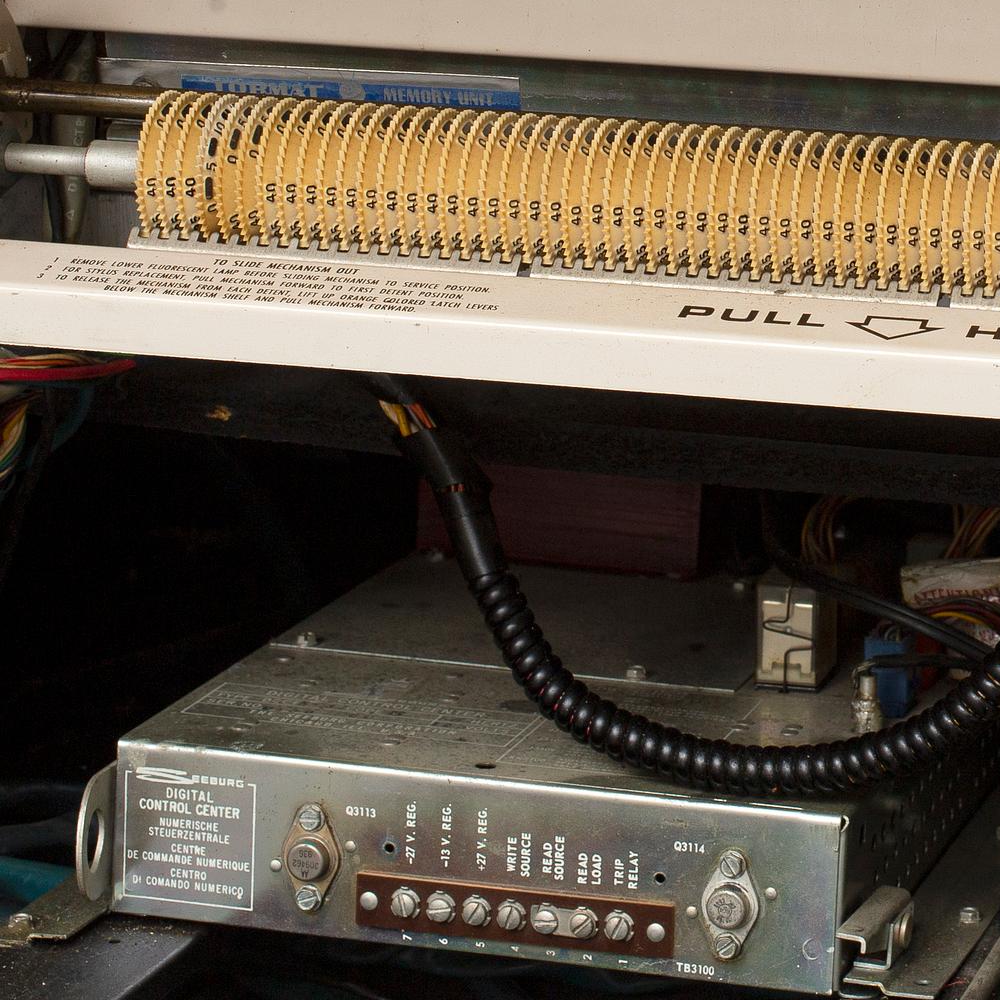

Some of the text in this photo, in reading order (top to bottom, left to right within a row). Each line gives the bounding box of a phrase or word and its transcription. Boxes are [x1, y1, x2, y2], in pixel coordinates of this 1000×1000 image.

[382, 86, 452, 105] MEMORY
[206, 162, 217, 172] 5
[286, 184, 297, 204] 40
[346, 188, 357, 208] 40
[407, 193, 418, 213] 40
[467, 197, 479, 217] 40
[529, 200, 541, 221] 40
[592, 204, 603, 225] 40
[654, 209, 665, 229] 40
[718, 213, 729, 233] 40
[780, 218, 791, 238] 40
[843, 222, 854, 242] 40
[908, 226, 919, 247] 40
[973, 230, 984, 251] 40
[70, 258, 108, 267] REMOVE
[110, 260, 144, 269] LOWER
[147, 263, 210, 274] FLUORESCENT
[243, 270, 279, 279] BEFORE
[282, 273, 321, 281] SLIDING
[323, 276, 380, 285] MECHANISM
[402, 281, 441, 290] SERVICE
[213, 258, 361, 275] TO SLIDE MECHANISM OUT
[62, 265, 82, 273] FOR
[85, 267, 120, 276] STYLUS
[191, 275, 215, 283] PULL
[219, 277, 276, 287] MECHANISM
[279, 281, 326, 290] FORWARD
[330, 284, 344, 292] TO
[347, 286, 376, 294] FIRST
[379, 288, 415, 296] DETENT
[72, 275, 112, 284] RELEASE
[135, 279, 192, 289] MECHANISM
[195, 283, 223, 292] FROM
[226, 286, 253, 294] EACH
[339, 294, 379, 303] ORANGE
[382, 297, 427, 306] COLORED
[430, 300, 462, 309] LATCH
[465, 303, 500, 311] LEVERS
[103, 284, 137, 293] BELOW
[140, 287, 157, 295] THE
[162, 288, 218, 299] MECHANISM
[222, 293, 251, 301] SHELF
[254, 295, 276, 303] AND
[279, 297, 303, 305] PULL
[307, 299, 365, 309] MECHANISM
[677, 304, 826, 328] PULL
[135, 766, 245, 789] SEEBURG
[166, 787, 214, 803] DIGITAL
[139, 797, 241, 819] CONTROL CENTER
[345, 805, 377, 818] Q3113
[406, 800, 417, 828] REG.
[442, 803, 452, 831] REG.
[159, 817, 219, 832] NUMERISCHE
[477, 807, 488, 834] REG.
[148, 826, 230, 845] STEUERZENTRALE
[406, 831, 416, 843] V.
[441, 834, 452, 846] V.
[477, 838, 487, 850] V.
[170, 843, 206, 856] CENTRE
[506, 836, 518, 872] WRITE
[520, 832, 532, 878] SOURCE
[673, 841, 705, 854] Q3114
[127, 849, 251, 873] DE COMMANDE NUMERIQUE
[542, 842, 553, 874] READ
[554, 835, 566, 881] SOURCE
[170, 868, 207, 881] CENTRO
[577, 852, 589, 885] READ
[591, 854, 602, 885] LOAD
[613, 858, 625, 886] TRIP
[627, 851, 639, 890] RELAY
[132, 874, 142, 884] DI
[145, 876, 190, 890] COMANDO
[402, 933, 413, 942] 7
[438, 937, 449, 945] 6
[675, 961, 715, 976] TB3100
